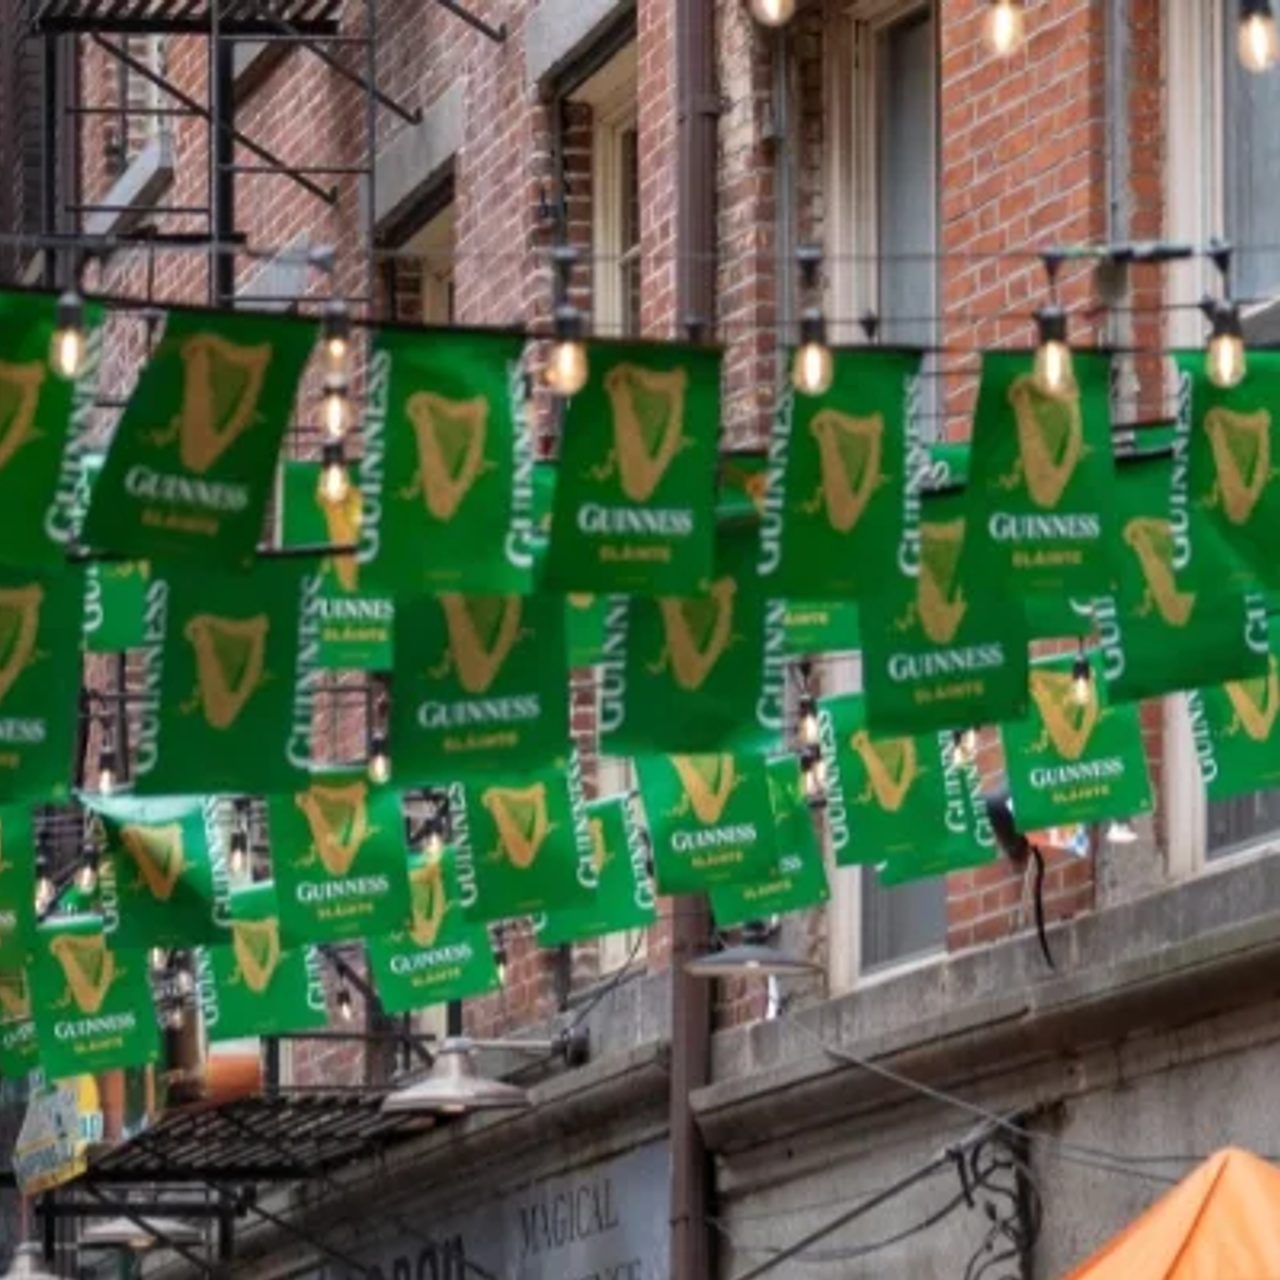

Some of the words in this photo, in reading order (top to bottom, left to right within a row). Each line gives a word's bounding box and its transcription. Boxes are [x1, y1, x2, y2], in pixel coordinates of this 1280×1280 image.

[358, 350, 390, 564] GUINNESS
[504, 356, 535, 567] GUINNESS
[898, 372, 928, 577] GUINNESS
[1170, 368, 1194, 570] GUINNESS
[124, 465, 248, 512] GUINNESS
[577, 503, 694, 536] GUINNESS
[988, 510, 1100, 540] GUINNESS
[318, 598, 394, 620] UINNES
[135, 580, 168, 775] GUINNESS
[286, 574, 322, 770] GUINNESS
[600, 594, 629, 732] GUINN
[756, 598, 786, 728] GUINN
[888, 645, 1004, 682] GUINNESS
[417, 694, 540, 730] GUINNESS
[1030, 756, 1124, 787] GUINNESS
[671, 824, 757, 853] GUINNESS
[297, 880, 389, 903] GUINNESS
[389, 945, 473, 975] GUINNESS
[55, 1014, 137, 1040] GUINNESS
[518, 1178, 621, 1259] MAGICAL
